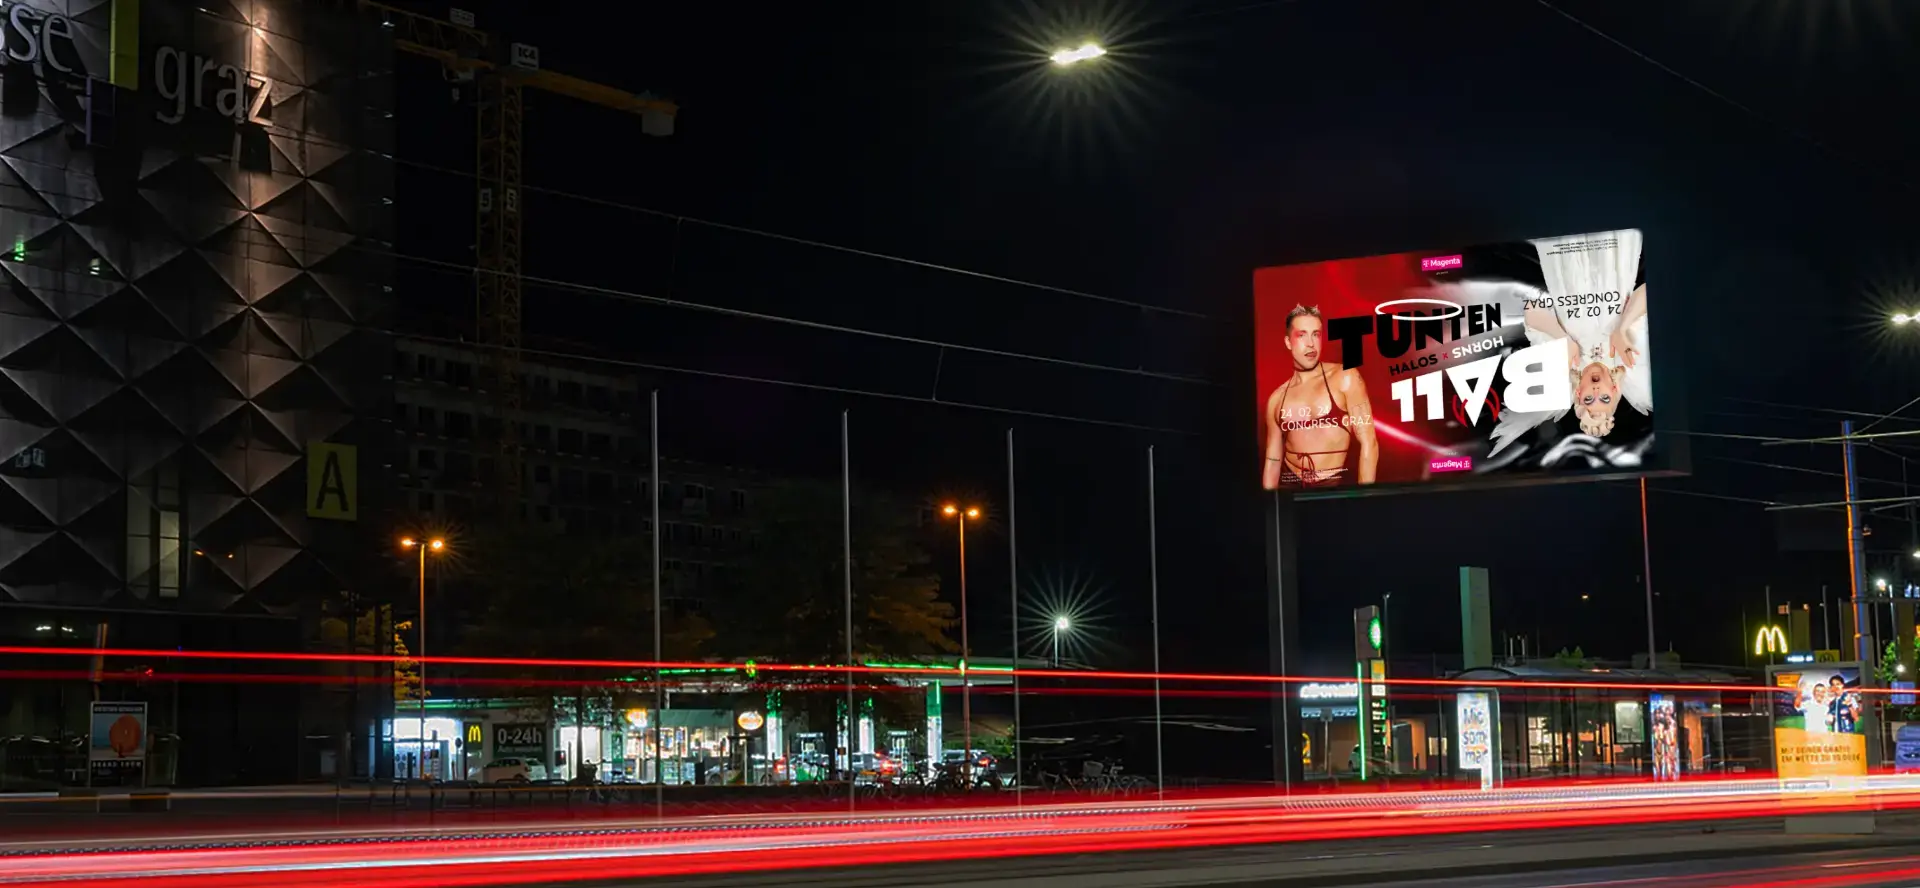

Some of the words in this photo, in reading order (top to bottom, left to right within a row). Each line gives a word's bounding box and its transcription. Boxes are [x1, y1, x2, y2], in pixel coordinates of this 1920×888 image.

[0, 3, 73, 73] se
[154, 45, 274, 127] graz
[1430, 257, 1461, 268] Magenta
[1523, 297, 1554, 310] GRAZ
[1558, 291, 1621, 307] CONGRESS
[1567, 307, 1581, 319] 24
[1587, 306, 1601, 317] 02
[1608, 304, 1622, 315] 24
[1327, 302, 1502, 371] TUNTEN
[1389, 353, 1439, 376] HALOS
[1452, 336, 1505, 359] HORNS
[1391, 337, 1573, 428] BALL
[1280, 408, 1293, 419] 24
[1298, 407, 1312, 417] 02
[1317, 405, 1330, 416] 24
[1280, 417, 1339, 432] CONGRESS
[1341, 414, 1372, 427] GRAZ
[1431, 459, 1463, 469] Magenta
[315, 450, 349, 512] A
[498, 727, 542, 744] 0-24h
